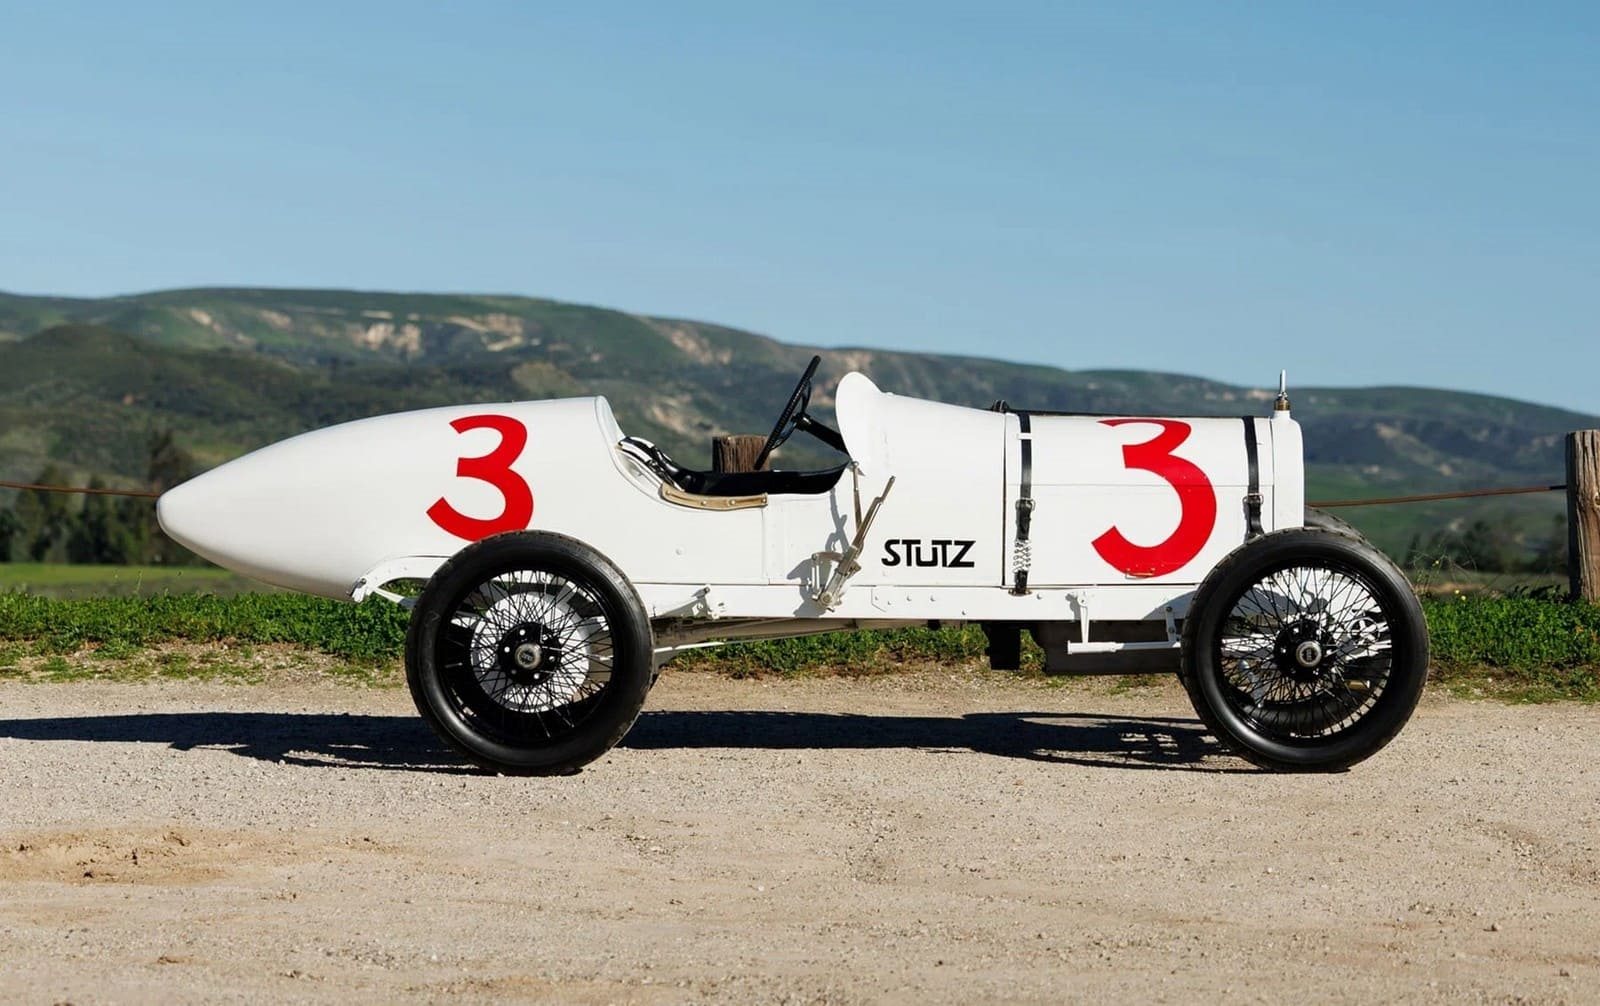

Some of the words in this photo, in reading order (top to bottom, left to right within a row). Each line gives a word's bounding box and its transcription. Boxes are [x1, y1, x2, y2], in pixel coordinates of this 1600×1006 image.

[427, 414, 534, 541] 3
[1092, 417, 1217, 578] 3
[881, 539, 977, 568] STUTZ
